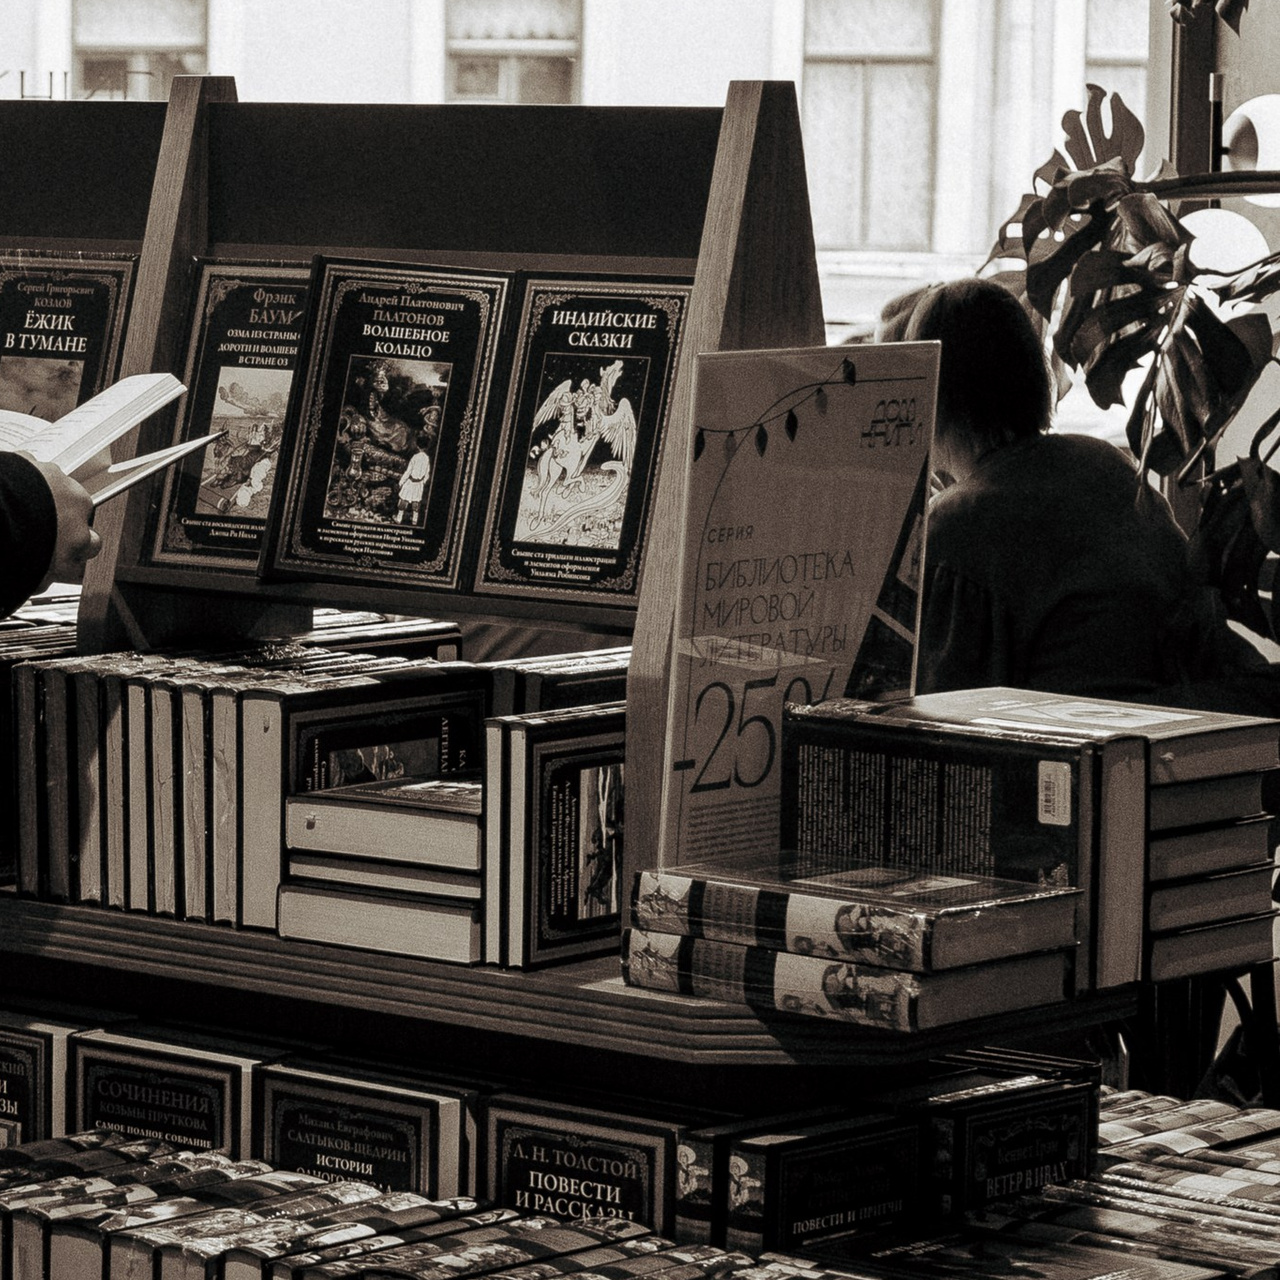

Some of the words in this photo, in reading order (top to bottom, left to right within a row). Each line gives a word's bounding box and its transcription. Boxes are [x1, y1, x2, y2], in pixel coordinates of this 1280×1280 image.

[17, 282, 45, 294] Сергей
[46, 283, 95, 297] Григорьевич
[253, 287, 297, 308] Фрэнк
[34, 297, 73, 309] КОЗЛОВ
[358, 292, 398, 308] Андрей
[400, 295, 465, 311] Платонович
[24, 310, 76, 331] ЁЖИК
[249, 308, 294, 325] БАУМ
[372, 309, 445, 327] ПЛАТОНОВ
[551, 309, 658, 329] ИНДИЙСКИЕ
[4, 332, 15, 348] В
[18, 333, 88, 353] ТУМАНЕ
[227, 328, 250, 339] ОЗМА
[250, 329, 261, 339] ИЗ
[262, 330, 297, 340] СТРАНЫ
[362, 323, 450, 343] ВОЛШЕБНОЕ
[568, 331, 634, 349] СКАЗКИ
[217, 343, 252, 352] ДОРОТИ
[374, 341, 433, 359] КОЛЬЦО
[238, 355, 244, 364] В
[244, 355, 277, 366] СТРАНЕ
[276, 357, 289, 367] ОЗ
[707, 525, 754, 544] СЕРИЯ
[705, 550, 856, 592] БИБЛИОТЕКА
[702, 585, 815, 630] МИРОВОЙ
[699, 623, 848, 668] ЛИТЕРАТУРЫ
[98, 1079, 210, 1114] СОЧИНЕНИЯ
[100, 1100, 146, 1120] КОЗЬМЫ
[147, 1109, 208, 1131] ПРУТКОВА
[95, 1120, 126, 1133] САМОЕ
[127, 1125, 164, 1140] ПОЛНОЕ
[164, 1132, 213, 1149] СОБРАНИЕ
[287, 1129, 407, 1163] САЛТЫКОВ-ЩЕДРИН
[316, 1153, 374, 1176] ИСТОРИЯ
[513, 1143, 529, 1160] Л.
[532, 1146, 550, 1163] Н.
[552, 1148, 637, 1180] ТОЛСТОЙ
[529, 1170, 621, 1204] ПОВЕСТИ
[986, 1170, 1024, 1199] ВЕТЕР
[1024, 1168, 1033, 1190] В
[515, 1189, 530, 1209] И
[792, 1212, 844, 1235] ПОВЕСТИ
[847, 1209, 856, 1223] И
[859, 1199, 903, 1221] ПРИТЧИ
